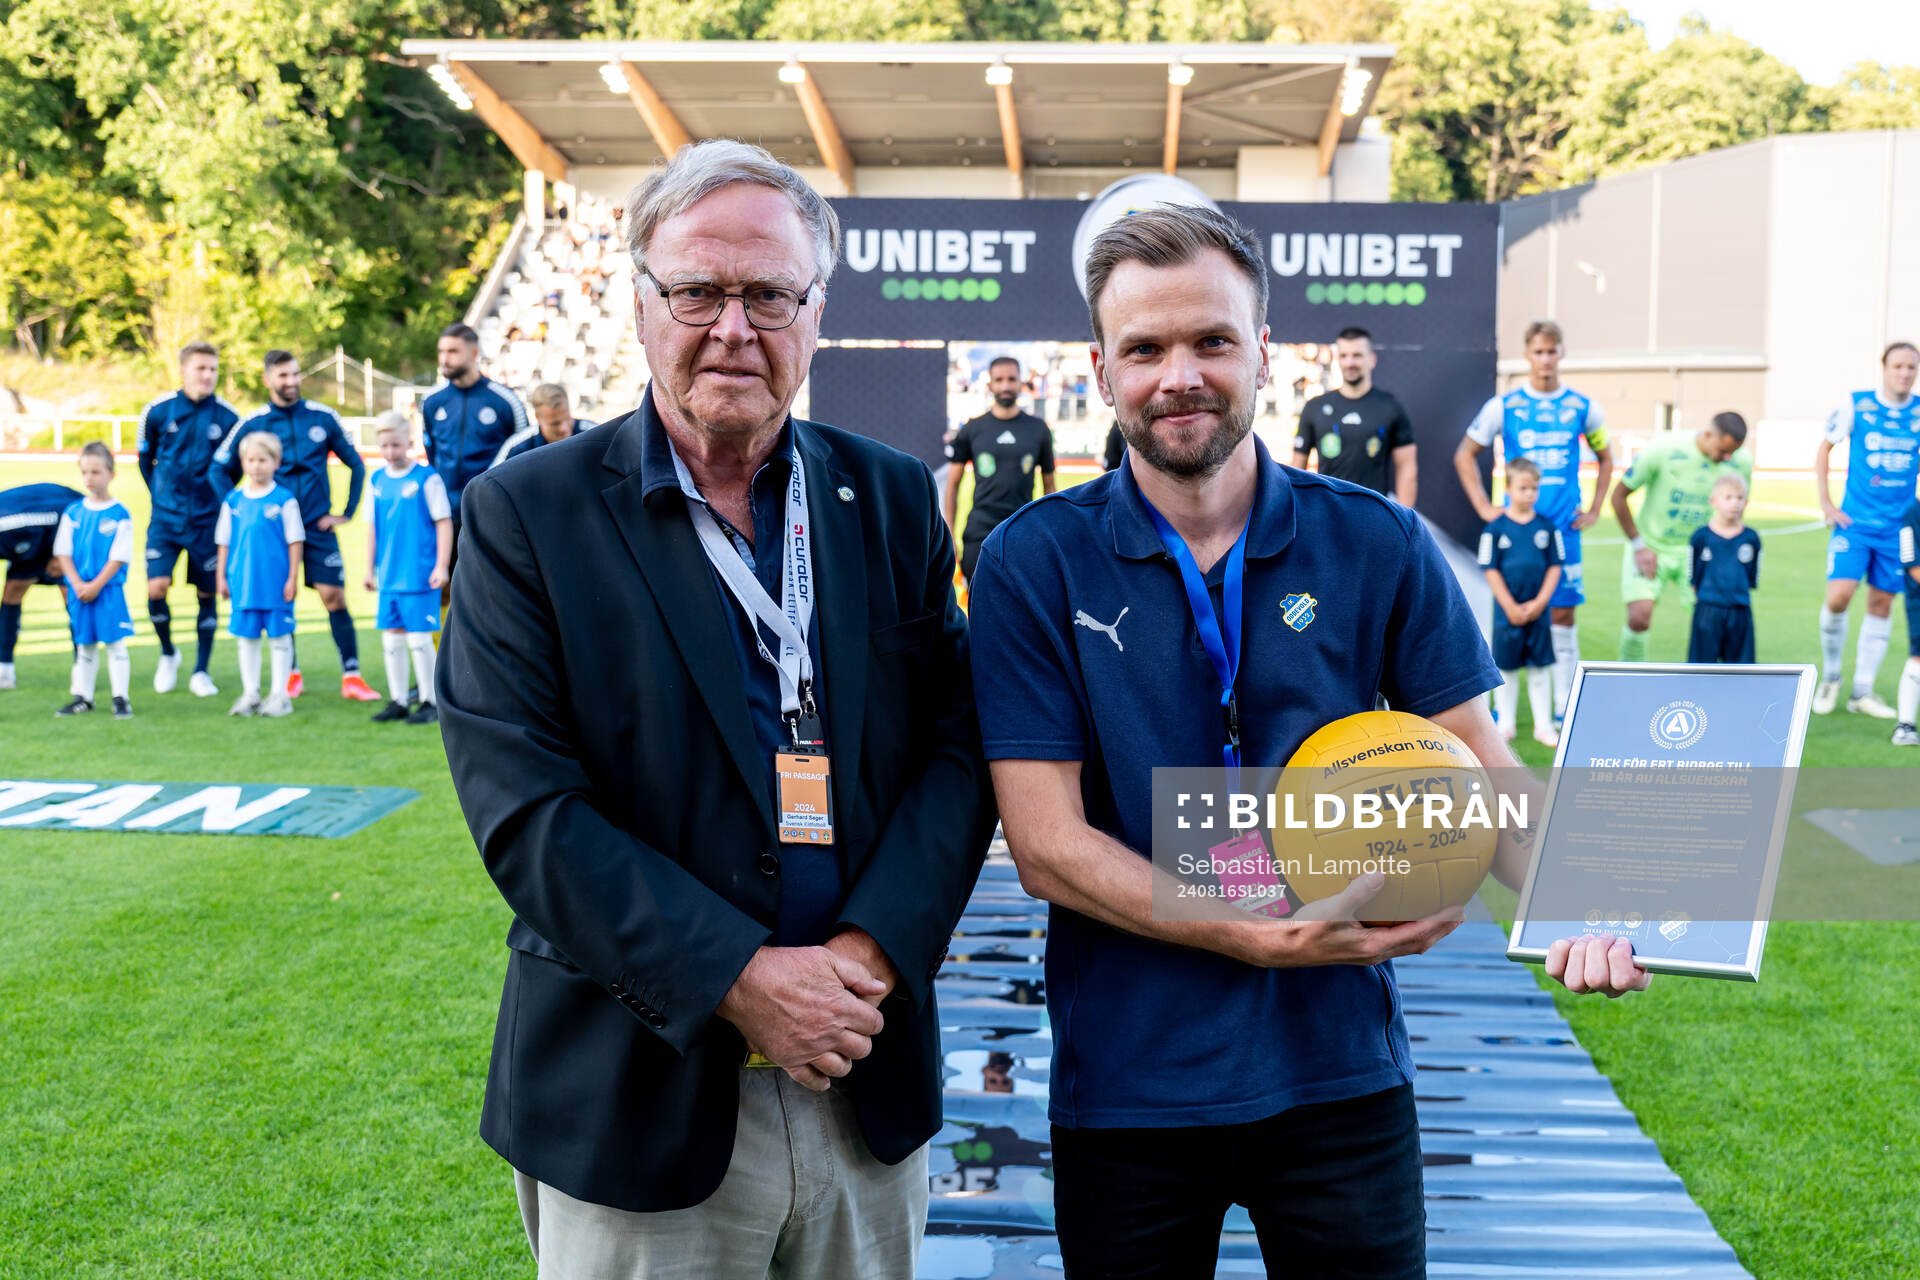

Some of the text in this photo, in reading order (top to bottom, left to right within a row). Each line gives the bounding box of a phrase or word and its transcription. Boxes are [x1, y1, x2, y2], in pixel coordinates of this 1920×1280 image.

[846, 229, 1036, 273] UNIBET
[1270, 232, 1462, 278] UNIBET
[795, 537, 809, 604] curator
[1296, 612, 1311, 626] 1932
[1323, 741, 1415, 780] Allsvenskan
[1416, 739, 1444, 752] 100
[1589, 757, 1620, 768] TACK
[1623, 757, 1648, 769] FÖR
[1676, 760, 1724, 772] BIDRAG
[1727, 761, 1753, 772] TILL
[793, 772, 827, 781] PASSAGE
[1615, 771, 1633, 784] ÅR
[1655, 774, 1748, 787] ALLSVENSKAN
[794, 803, 816, 812] 2024
[1366, 839, 1408, 857] 1924
[1429, 828, 1467, 848] 2024
